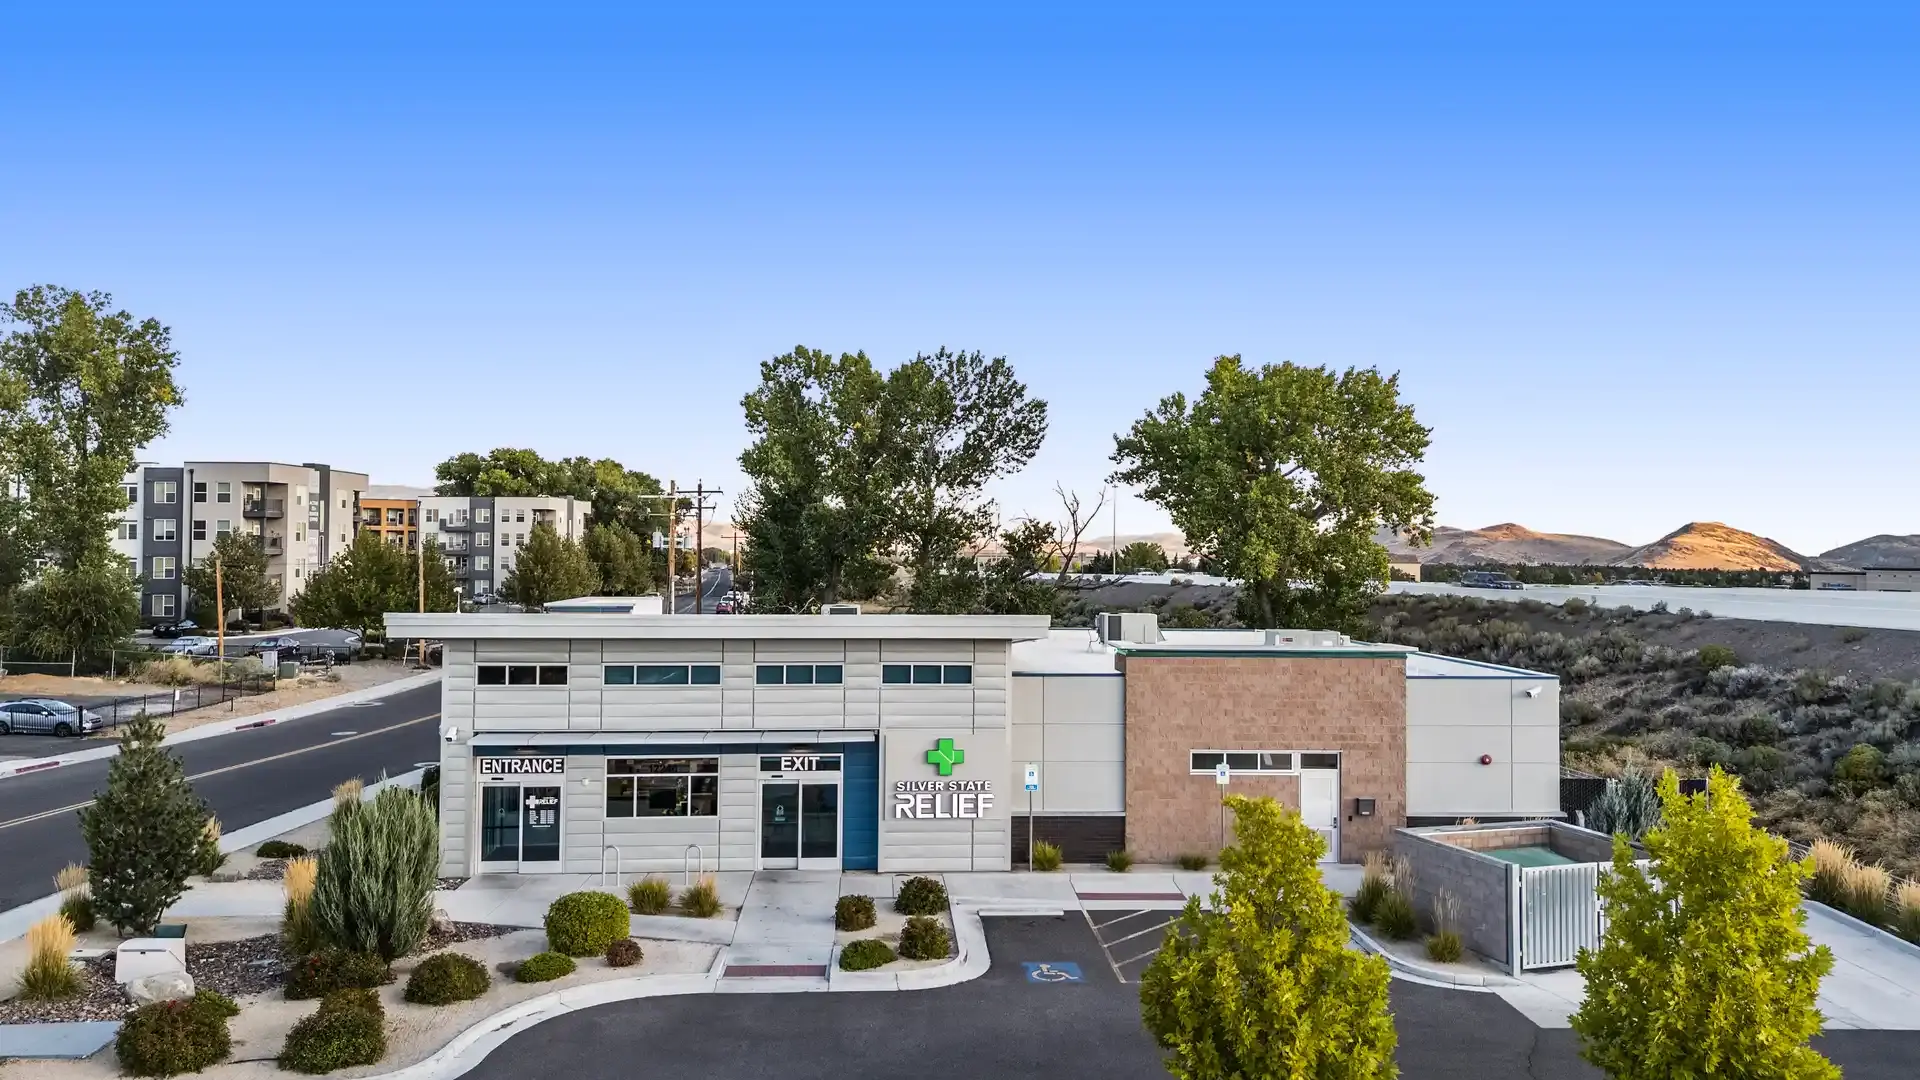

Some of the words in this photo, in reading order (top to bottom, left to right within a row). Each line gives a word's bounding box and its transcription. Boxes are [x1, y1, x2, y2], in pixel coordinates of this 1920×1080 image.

[482, 759, 563, 774] ENTRANCE
[781, 756, 820, 771] EXIT
[896, 781, 945, 791] SILVER
[948, 780, 992, 791] STATE
[895, 793, 995, 818] RELIEF
